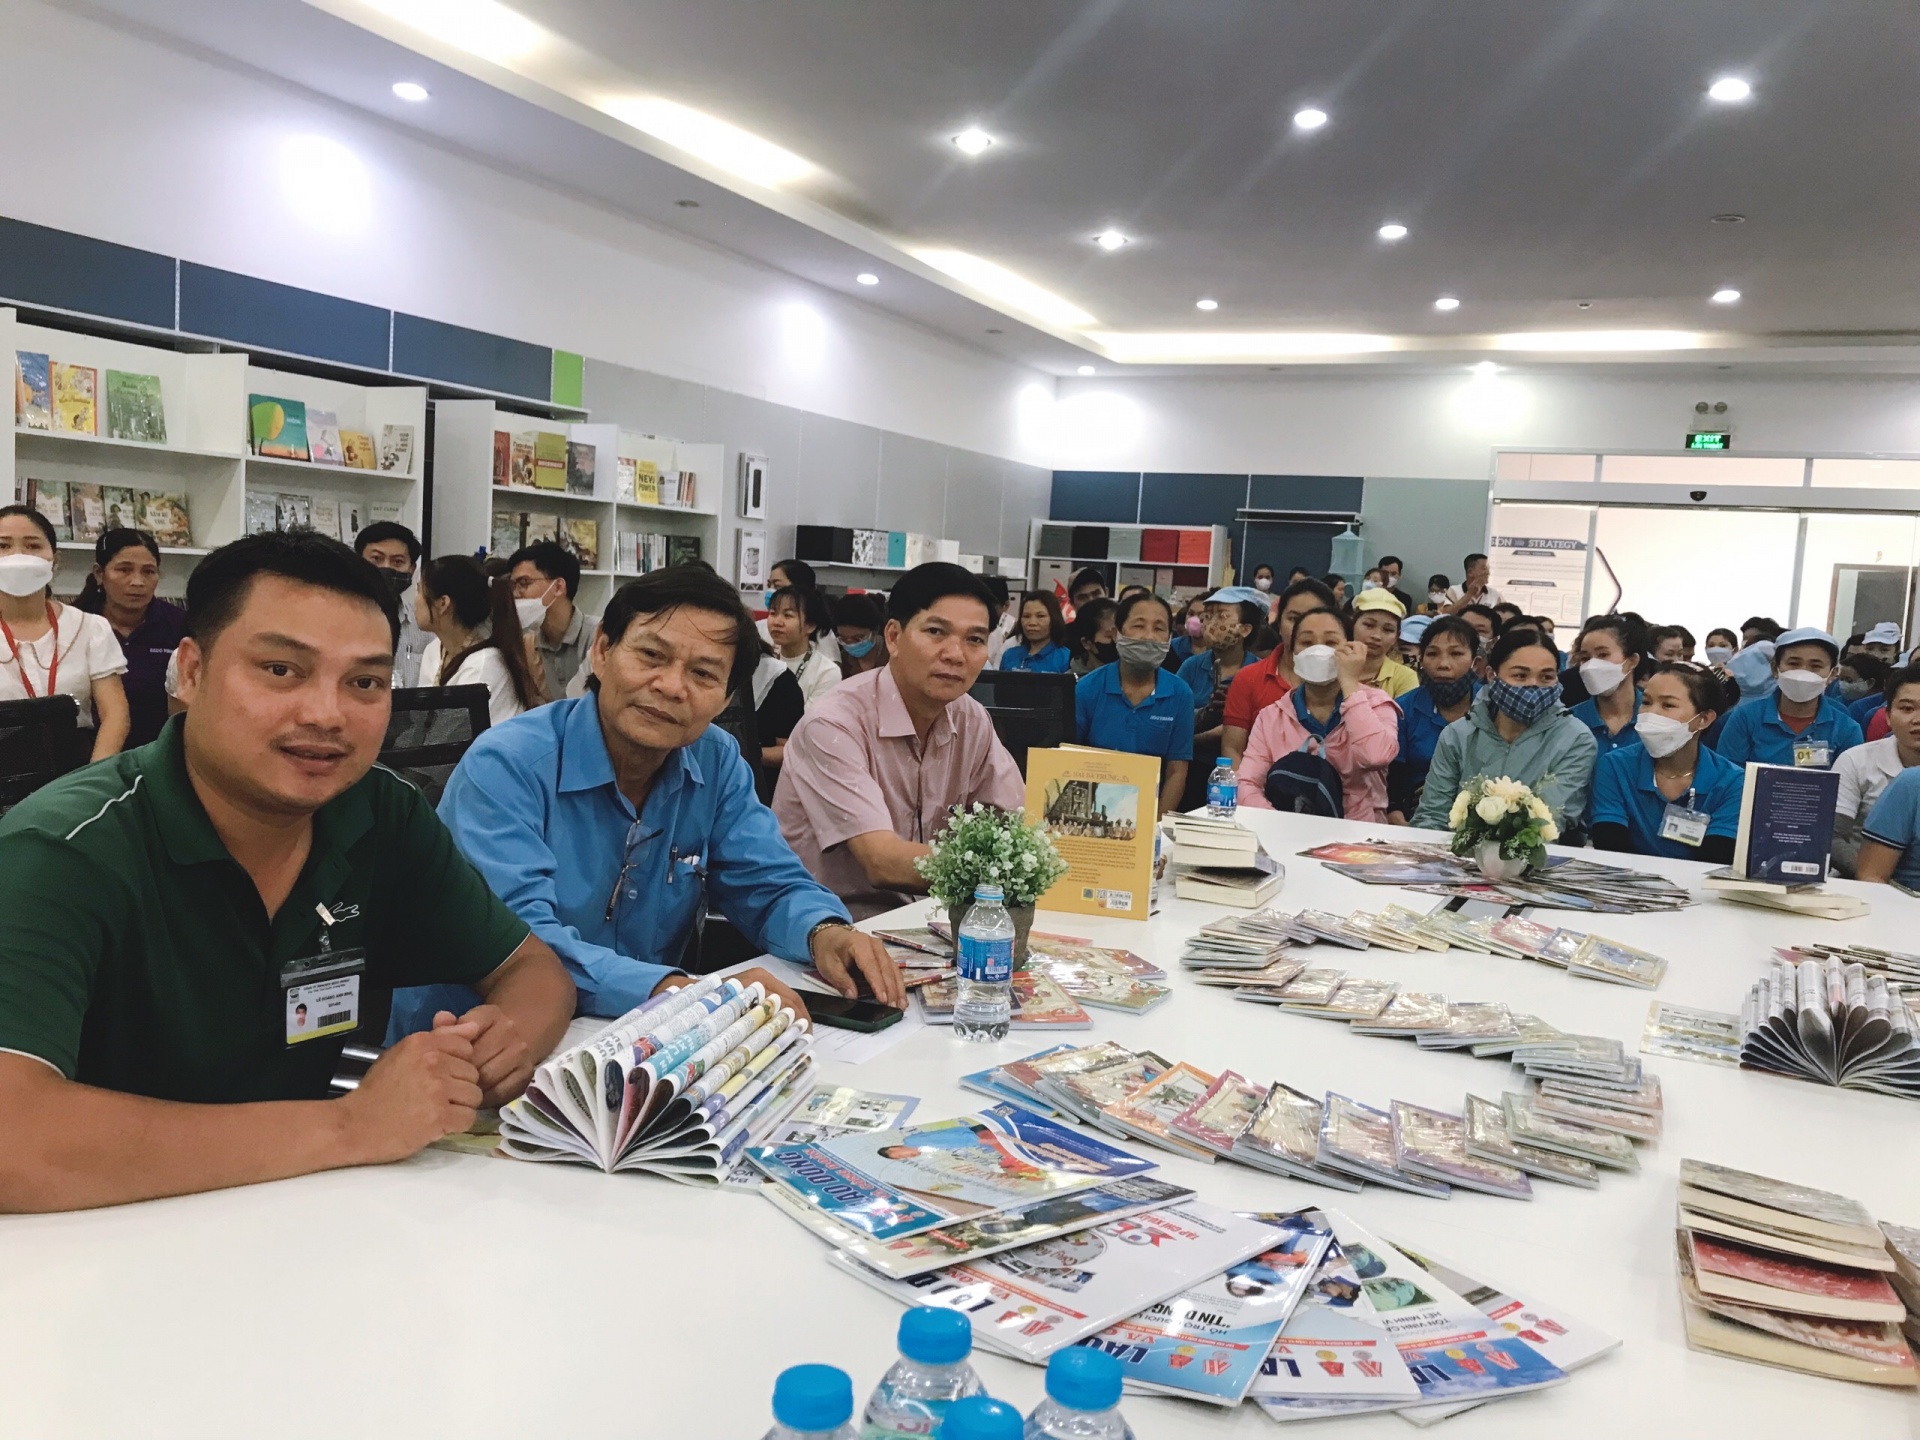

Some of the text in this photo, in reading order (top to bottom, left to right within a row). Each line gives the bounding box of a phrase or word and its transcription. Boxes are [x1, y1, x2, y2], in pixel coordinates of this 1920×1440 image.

[1694, 434, 1722, 442] EXIT
[1527, 539, 1578, 549] STRATEGY
[1797, 750, 1812, 760] 01
[774, 1151, 839, 1186] ĐỘNG
[1151, 1303, 1198, 1320] DNG
